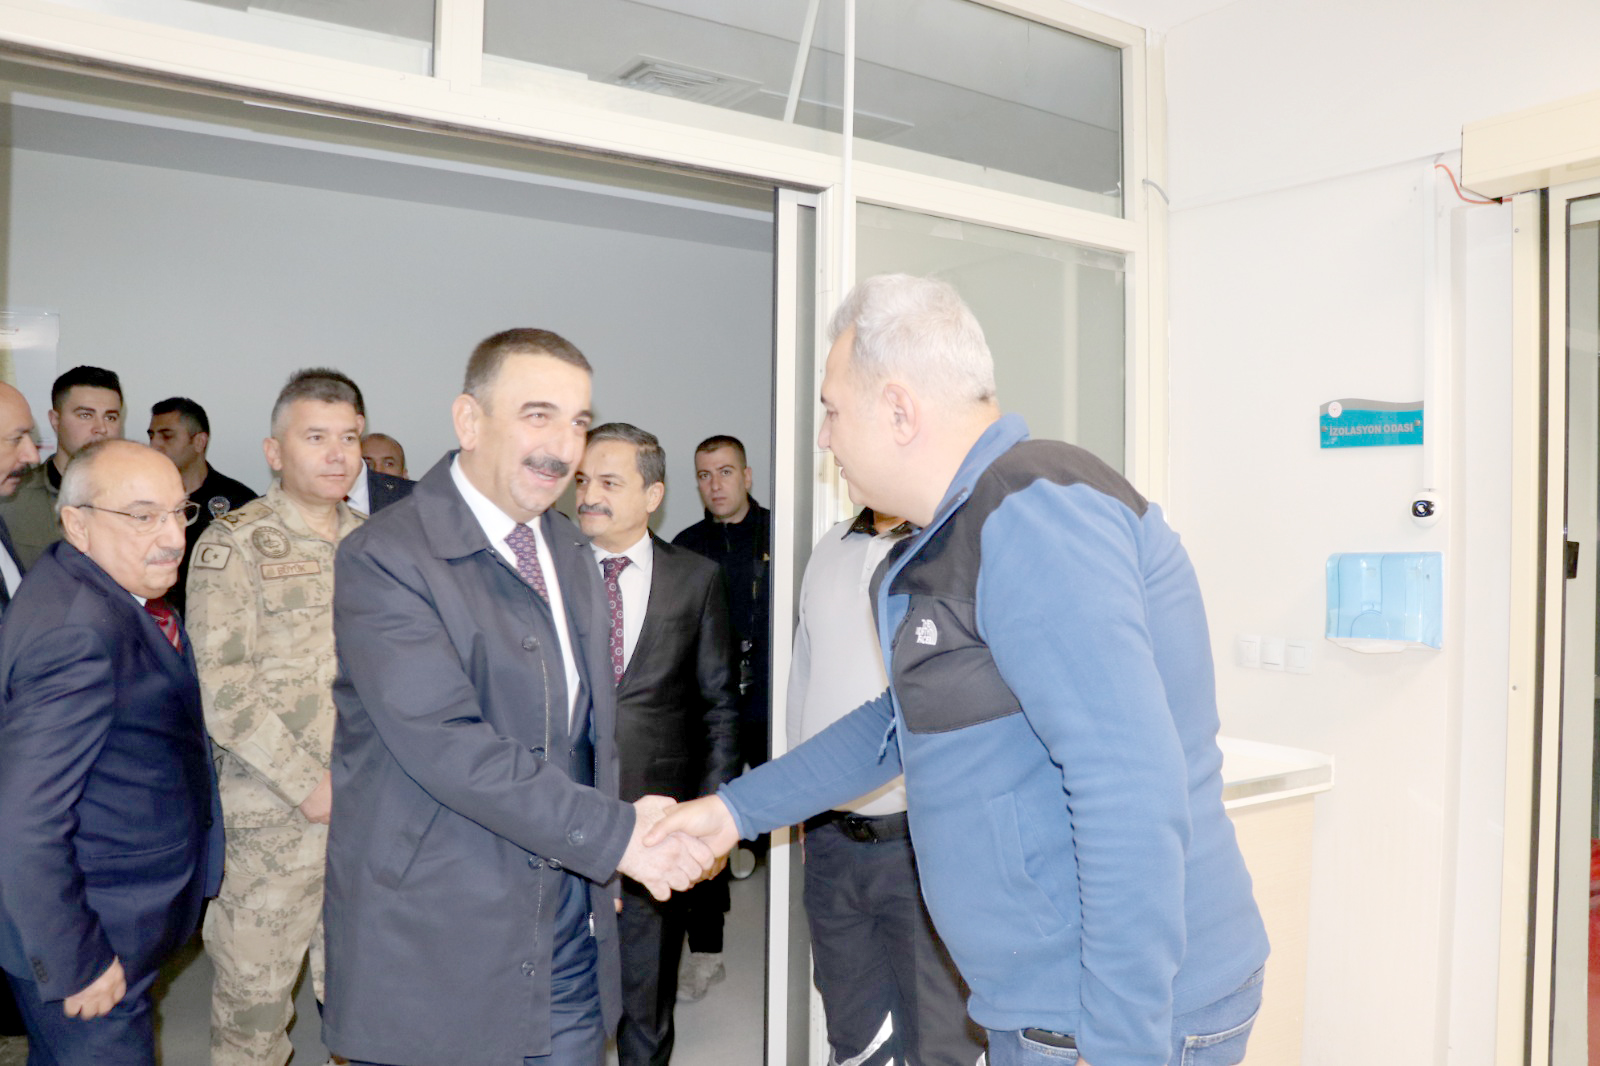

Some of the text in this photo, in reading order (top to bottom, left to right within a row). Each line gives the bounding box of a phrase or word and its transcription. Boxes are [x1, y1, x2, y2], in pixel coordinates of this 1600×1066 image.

[1329, 423, 1413, 436] İZOLASYON ODASI
[277, 564, 306, 575] BÜYÜK
